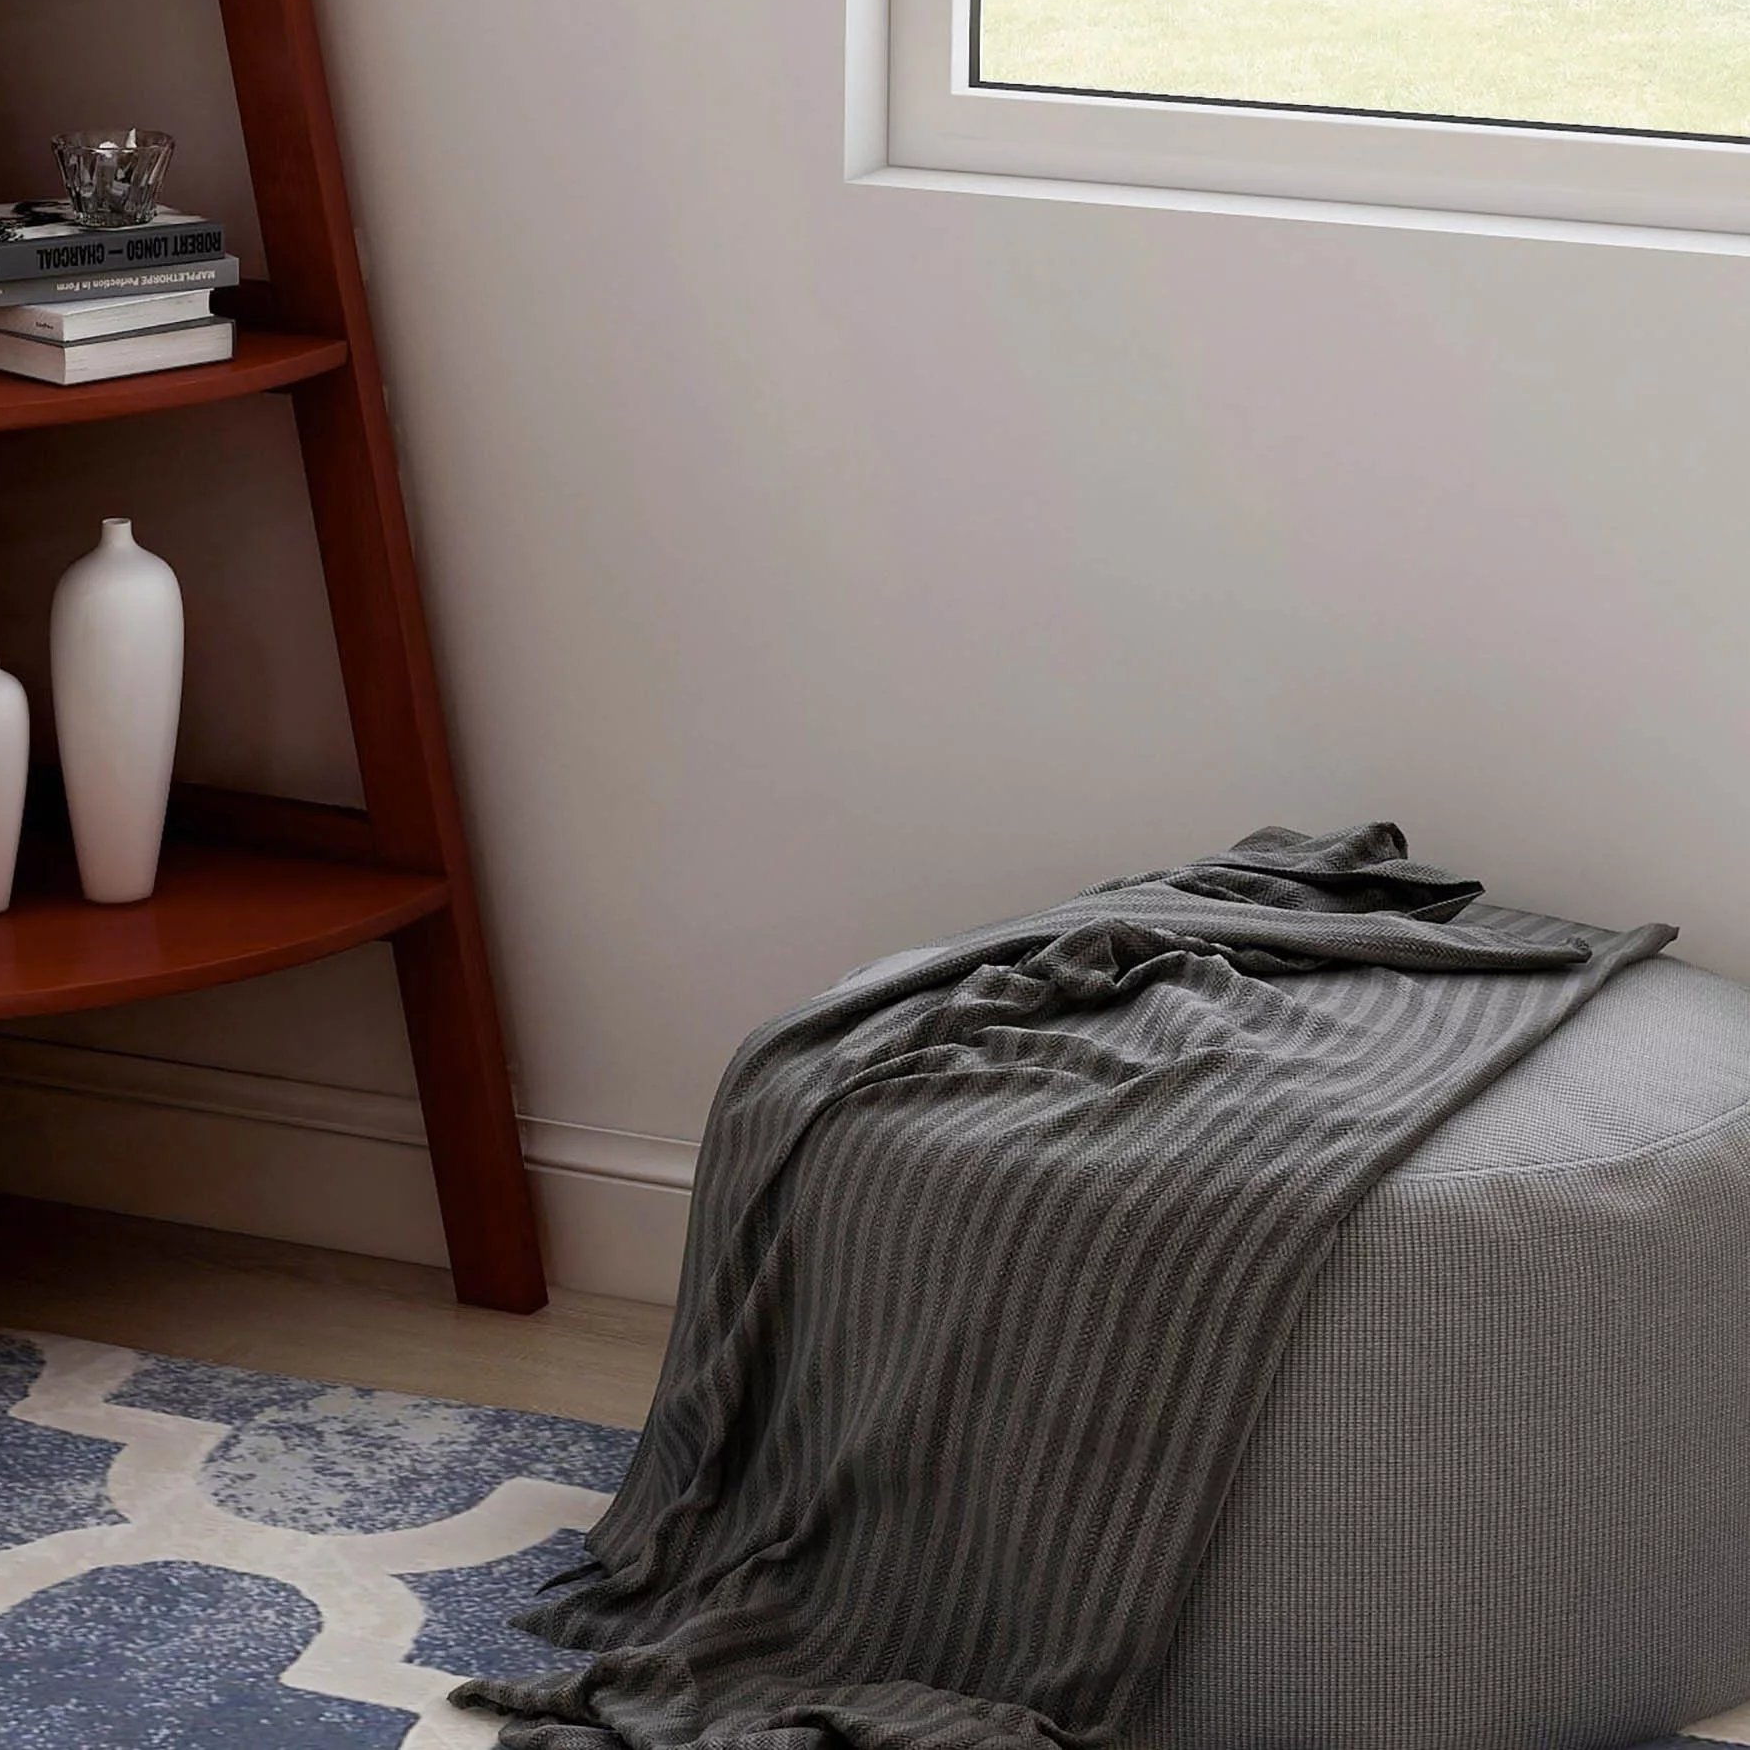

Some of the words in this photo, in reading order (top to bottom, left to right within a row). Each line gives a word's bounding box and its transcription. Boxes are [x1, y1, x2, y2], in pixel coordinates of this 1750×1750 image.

[127, 235, 167, 261] LONGO
[171, 231, 222, 256] ROBERT
[37, 243, 105, 270] CHARCOAL
[56, 281, 80, 291] Form
[92, 277, 139, 289] Perfection
[140, 270, 216, 286] MAPPLETHORPE
